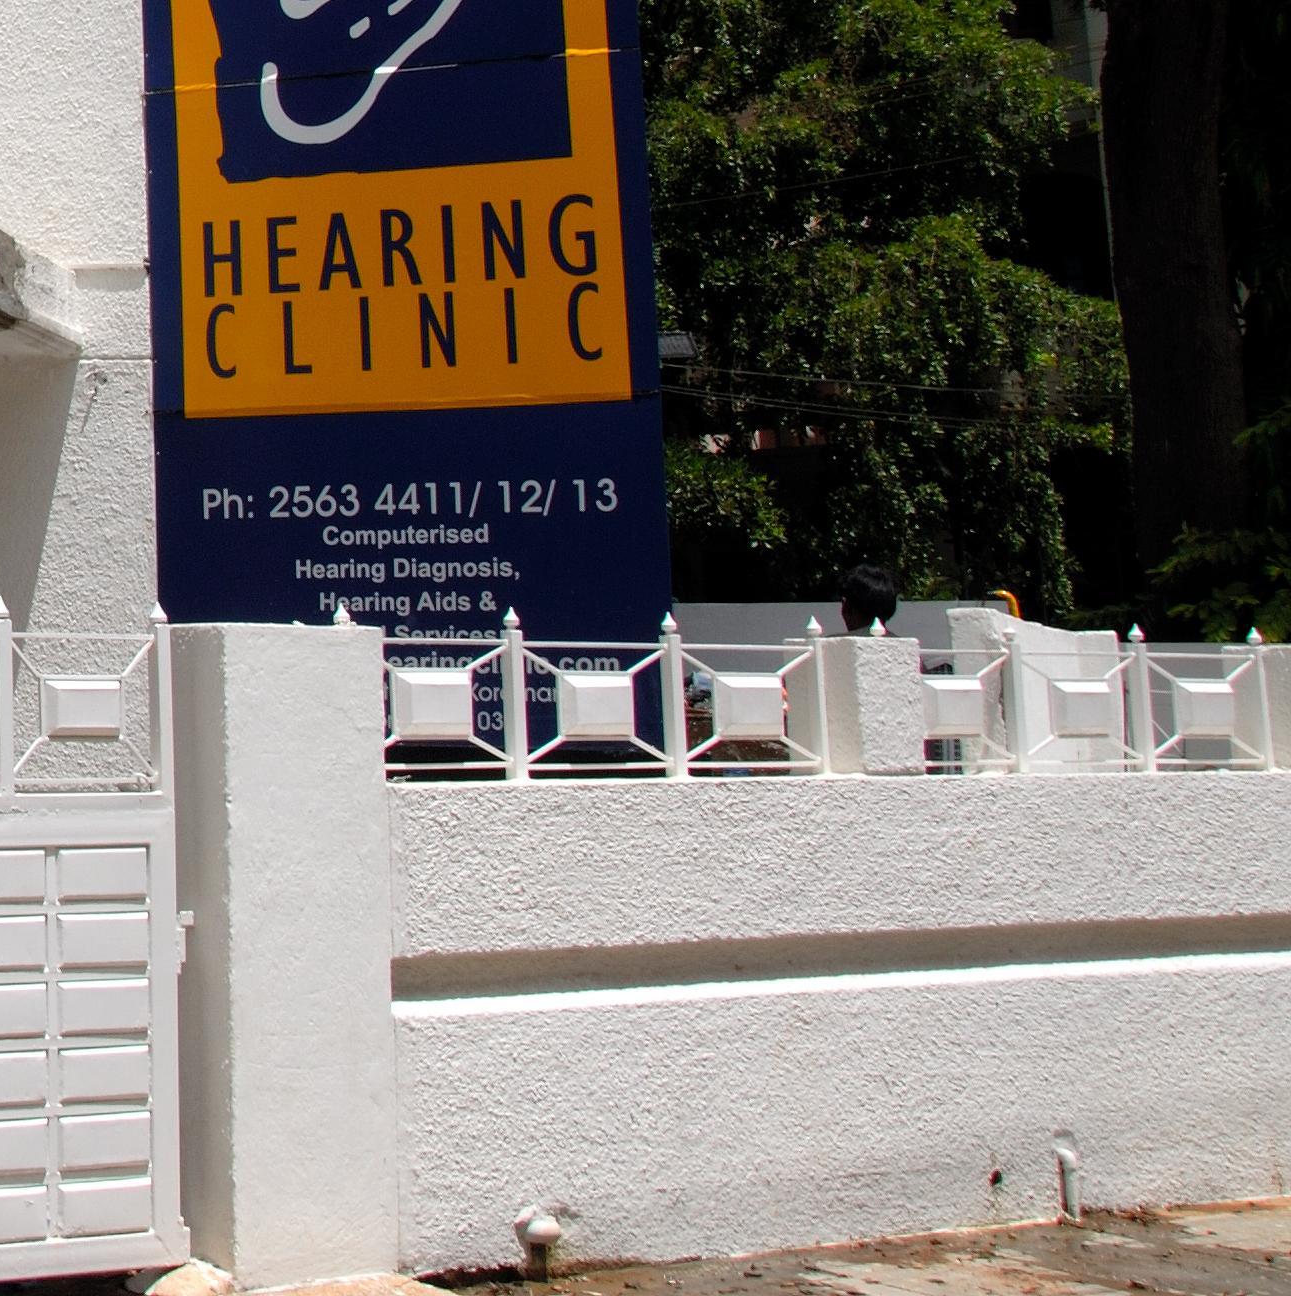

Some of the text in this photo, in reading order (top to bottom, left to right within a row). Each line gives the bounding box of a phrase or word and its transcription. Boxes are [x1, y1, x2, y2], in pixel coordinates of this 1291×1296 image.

[202, 194, 597, 297] HEARING
[206, 282, 602, 378] CLINIC
[203, 488, 254, 520] Ph:
[269, 483, 361, 518] 2563
[572, 478, 618, 512] 13
[322, 523, 489, 549] Computerised
[295, 557, 519, 583] Hearing Diagnosis,
[319, 590, 497, 616] Hearing Aids &
